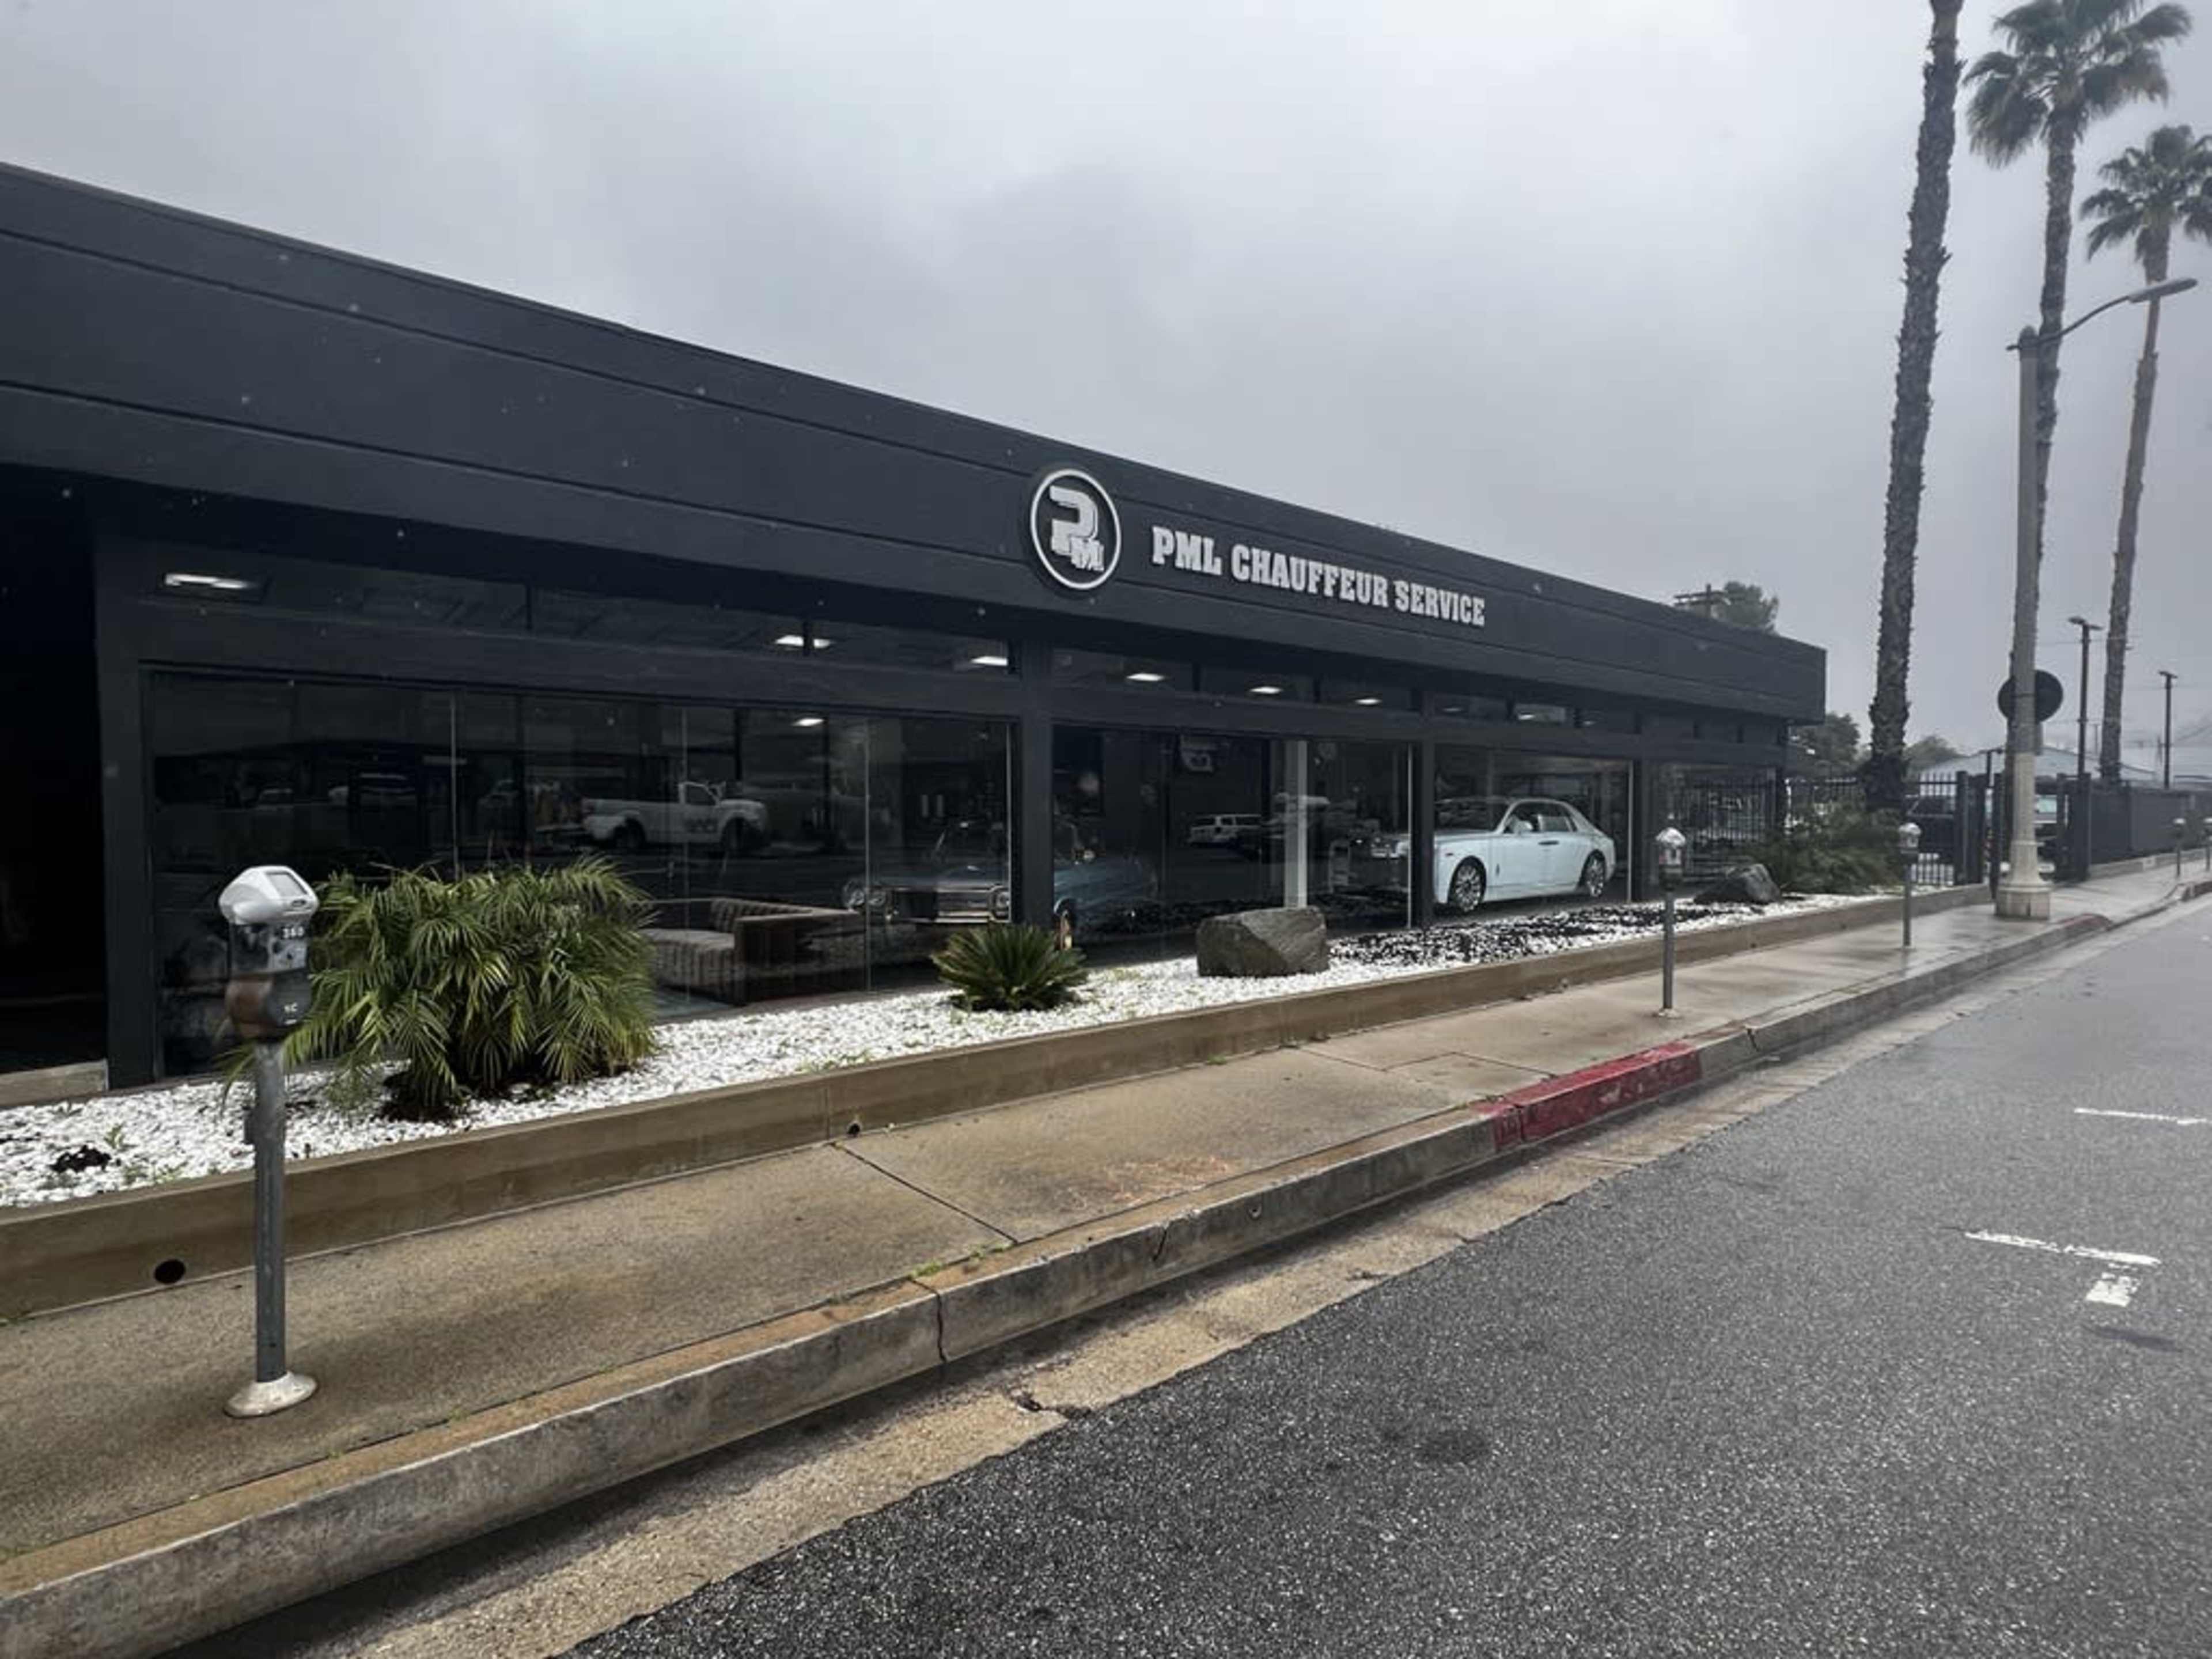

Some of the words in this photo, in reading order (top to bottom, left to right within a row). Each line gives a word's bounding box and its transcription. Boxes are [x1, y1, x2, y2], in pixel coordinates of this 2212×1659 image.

[1153, 525, 1222, 575] PML
[1231, 543, 1389, 608] CHAUFFEUR
[1393, 579, 1485, 627] SERVICE
